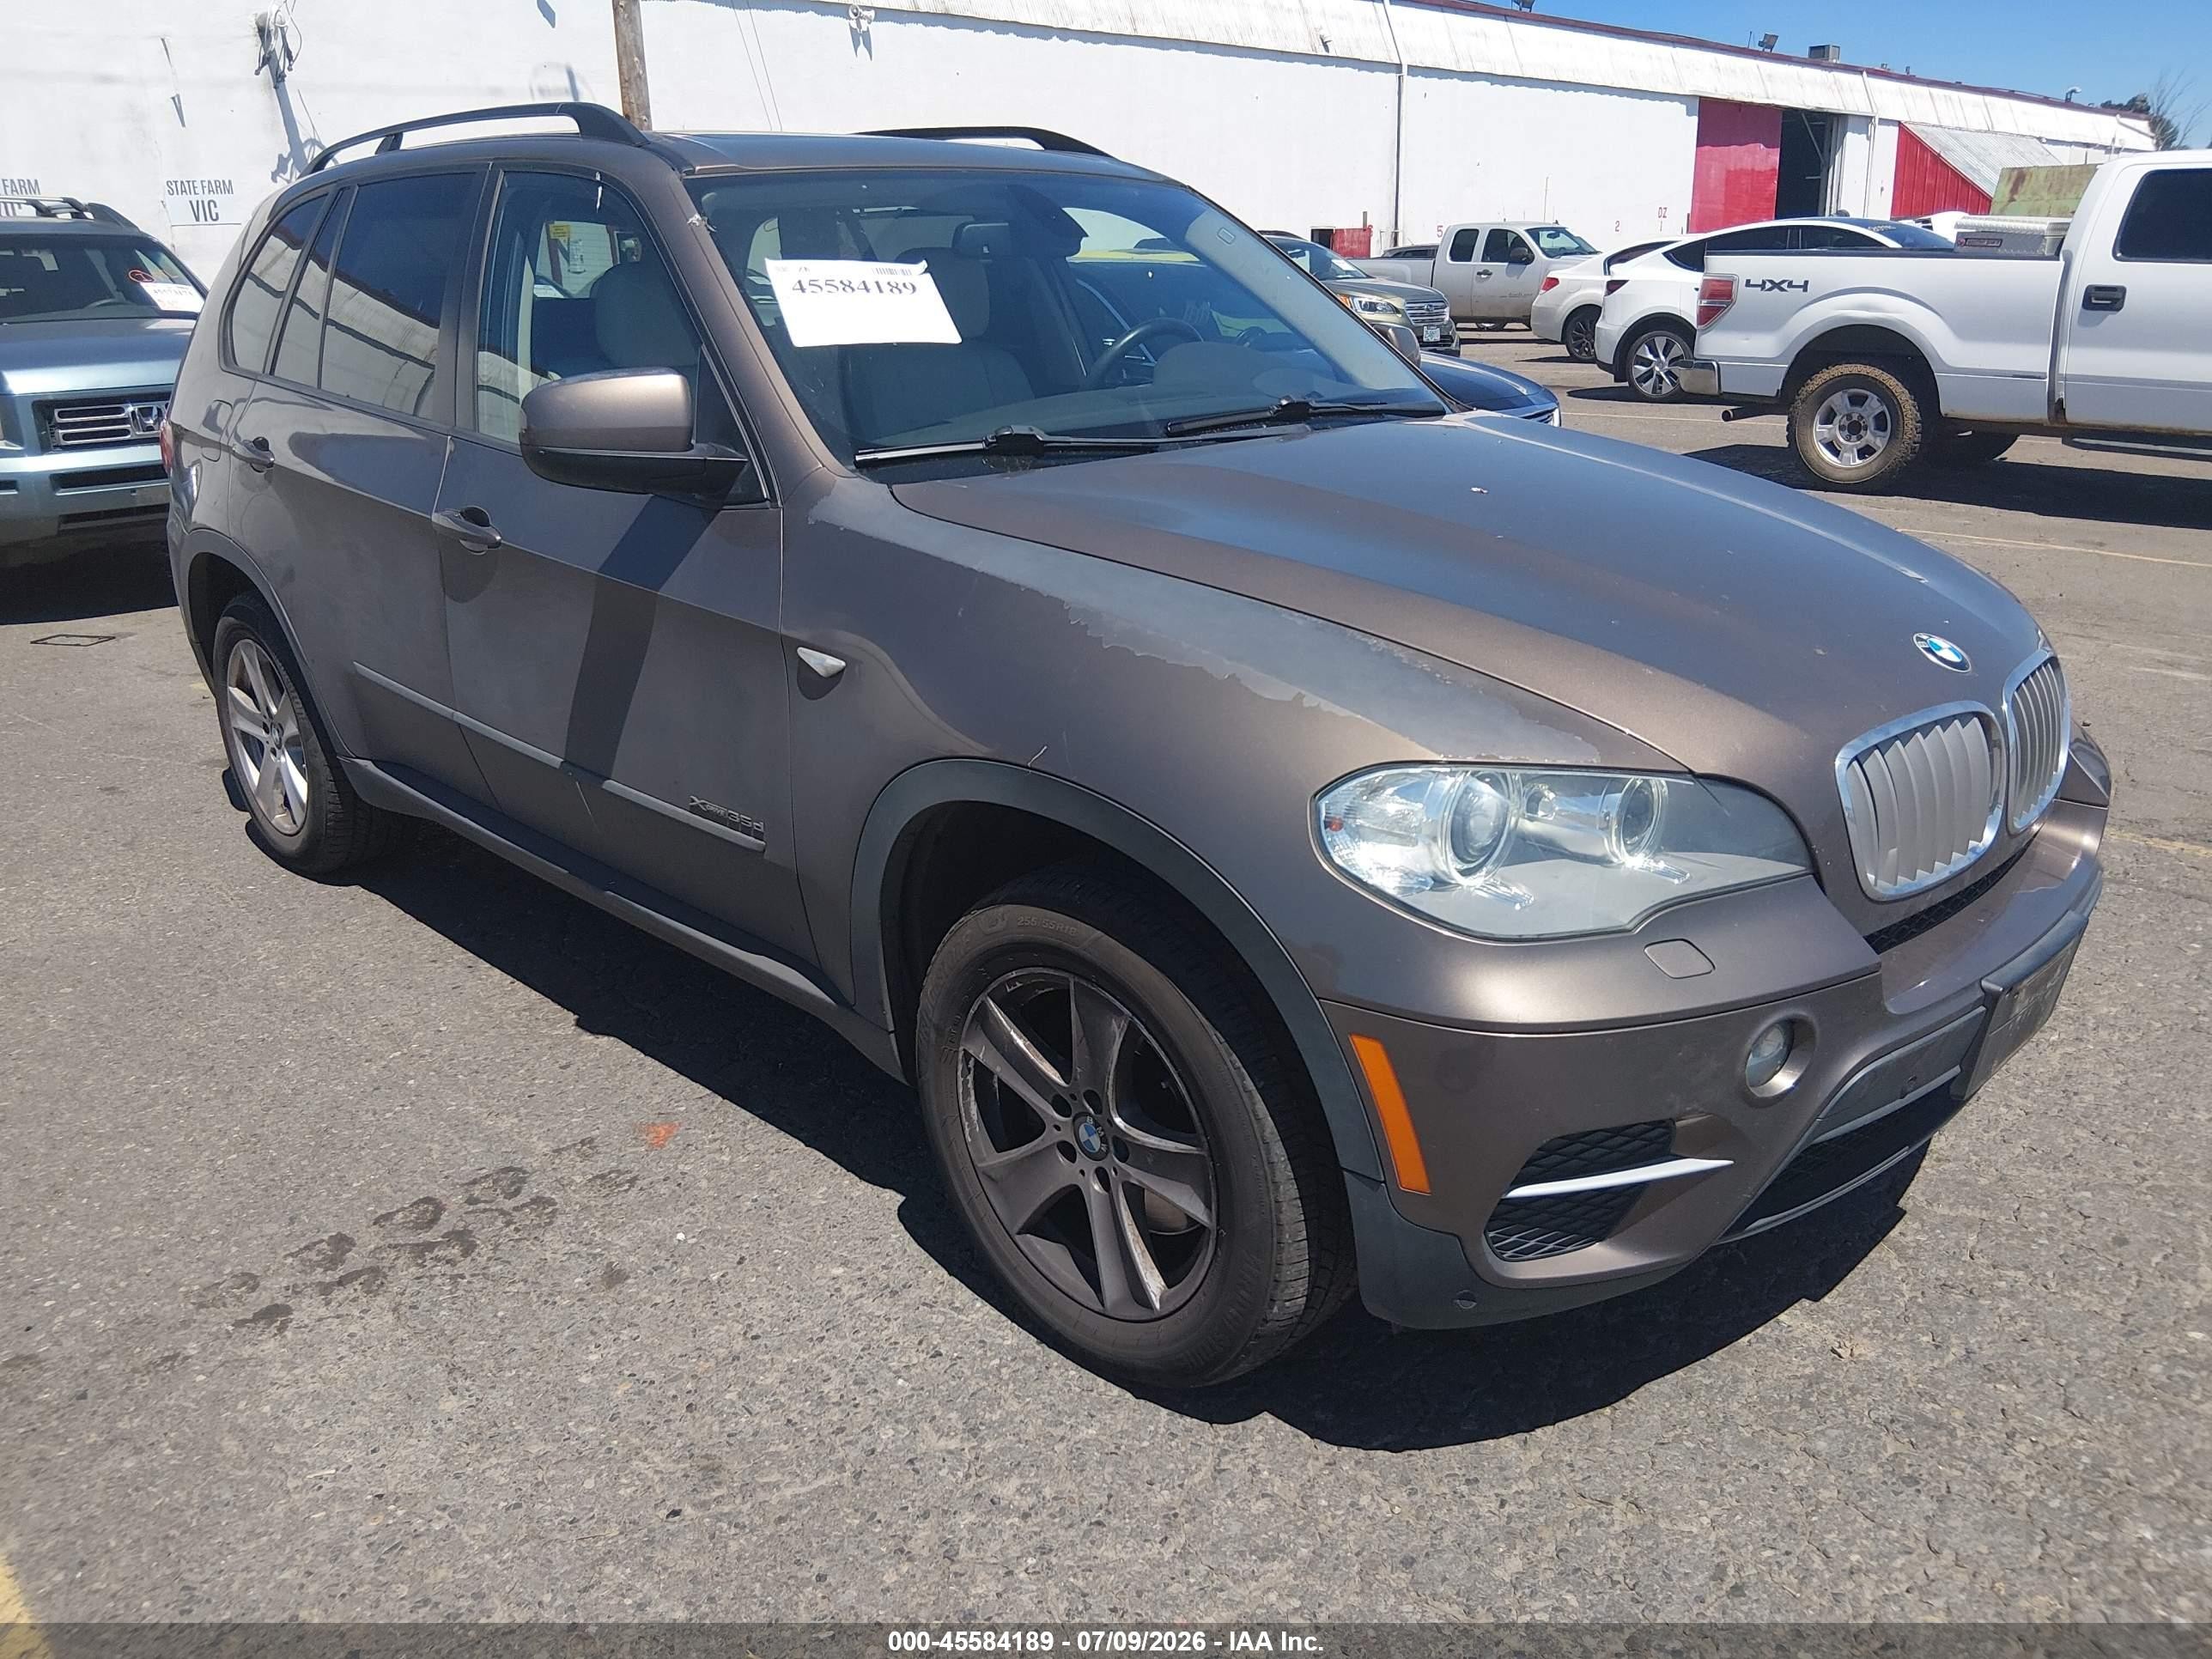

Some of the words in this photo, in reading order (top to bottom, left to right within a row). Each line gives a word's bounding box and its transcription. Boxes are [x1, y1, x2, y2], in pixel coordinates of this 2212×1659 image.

[1, 179, 41, 196] FARM
[166, 179, 198, 196] STATE
[201, 179, 234, 195] FARM
[189, 200, 220, 222] VIC
[792, 279, 917, 295] 45584189
